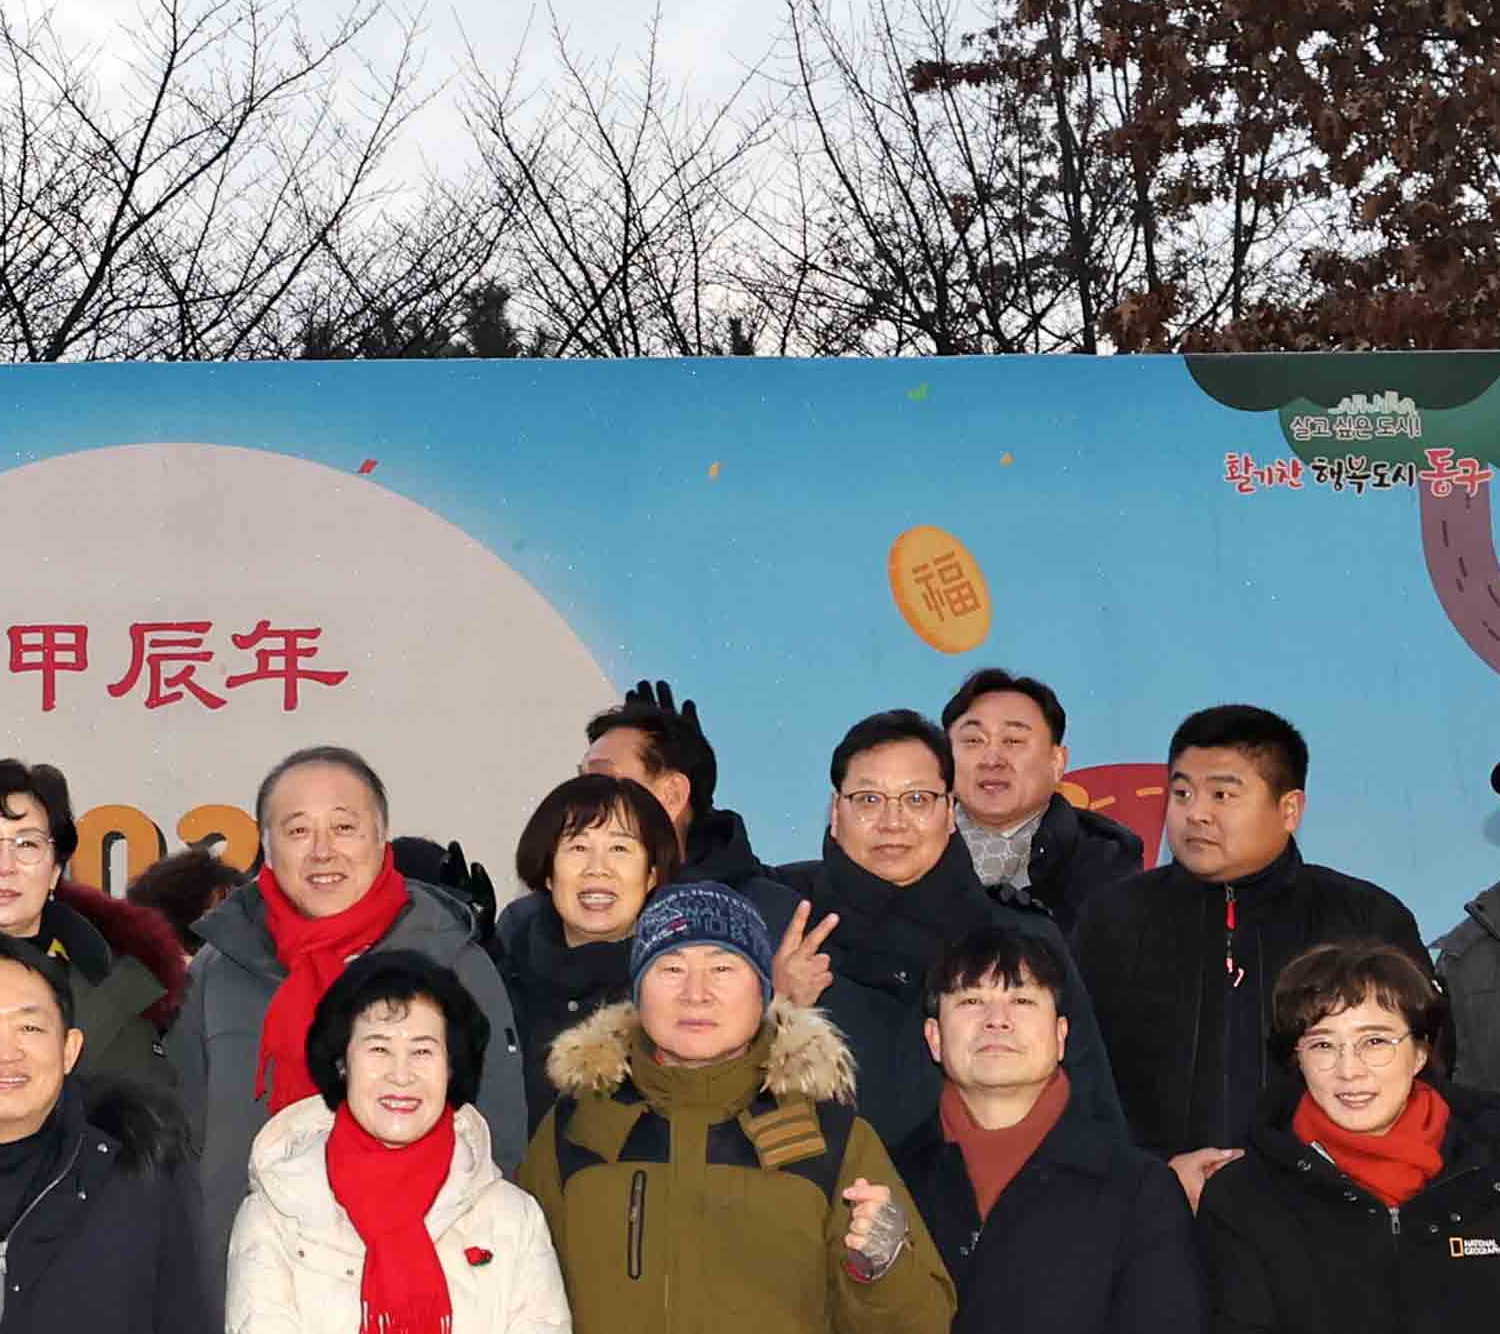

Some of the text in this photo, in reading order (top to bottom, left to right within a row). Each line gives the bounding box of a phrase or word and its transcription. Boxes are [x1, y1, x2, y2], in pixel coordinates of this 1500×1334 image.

[1290, 415, 1332, 441] 살고
[1333, 415, 1373, 441] 싶은
[1223, 447, 1493, 497] 활기찬 행복도시 동구
[911, 550, 984, 623] 福
[6, 619, 350, 712] 甲辰年
